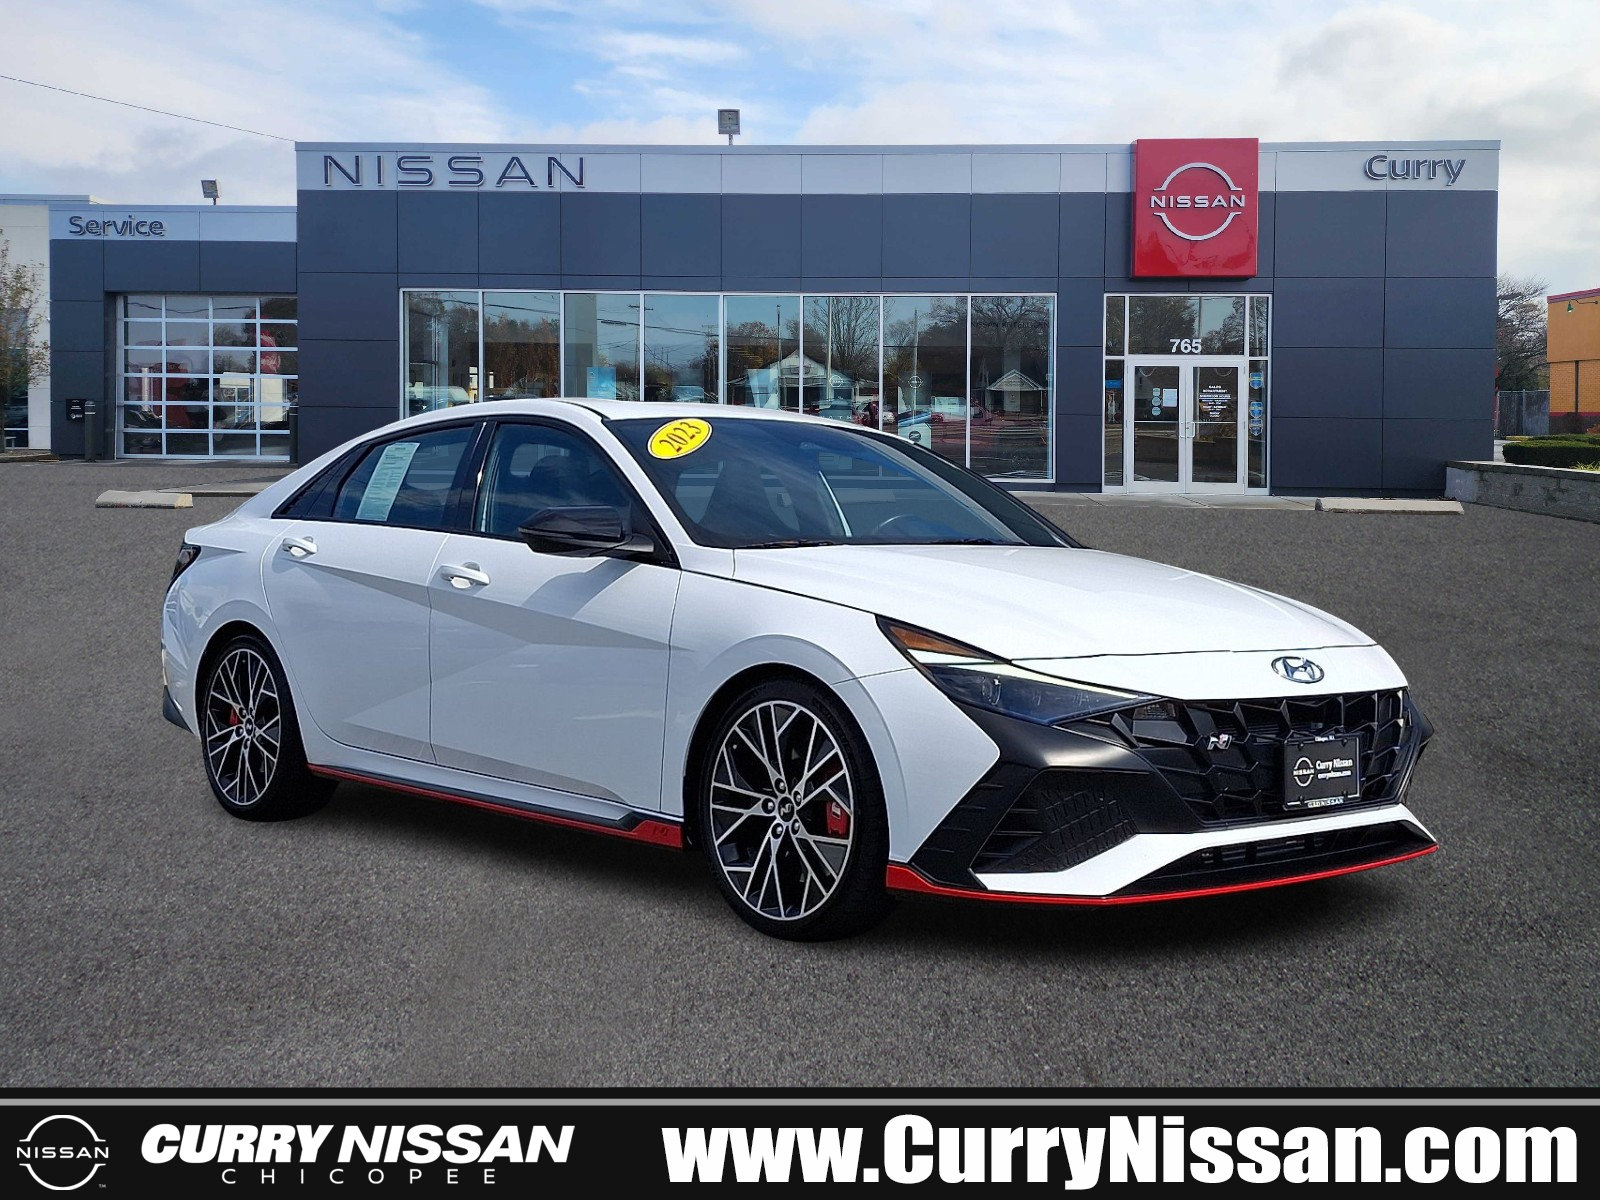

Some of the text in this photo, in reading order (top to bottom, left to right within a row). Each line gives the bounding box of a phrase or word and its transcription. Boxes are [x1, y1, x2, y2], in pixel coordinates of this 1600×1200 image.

[323, 154, 585, 189] NISSAN
[1364, 154, 1466, 186] Curry
[1150, 193, 1246, 210] NISSAN
[68, 214, 165, 237] Service
[1169, 338, 1203, 354] 765
[659, 421, 702, 453] 2023
[1316, 758, 1353, 770] Curry Nissan
